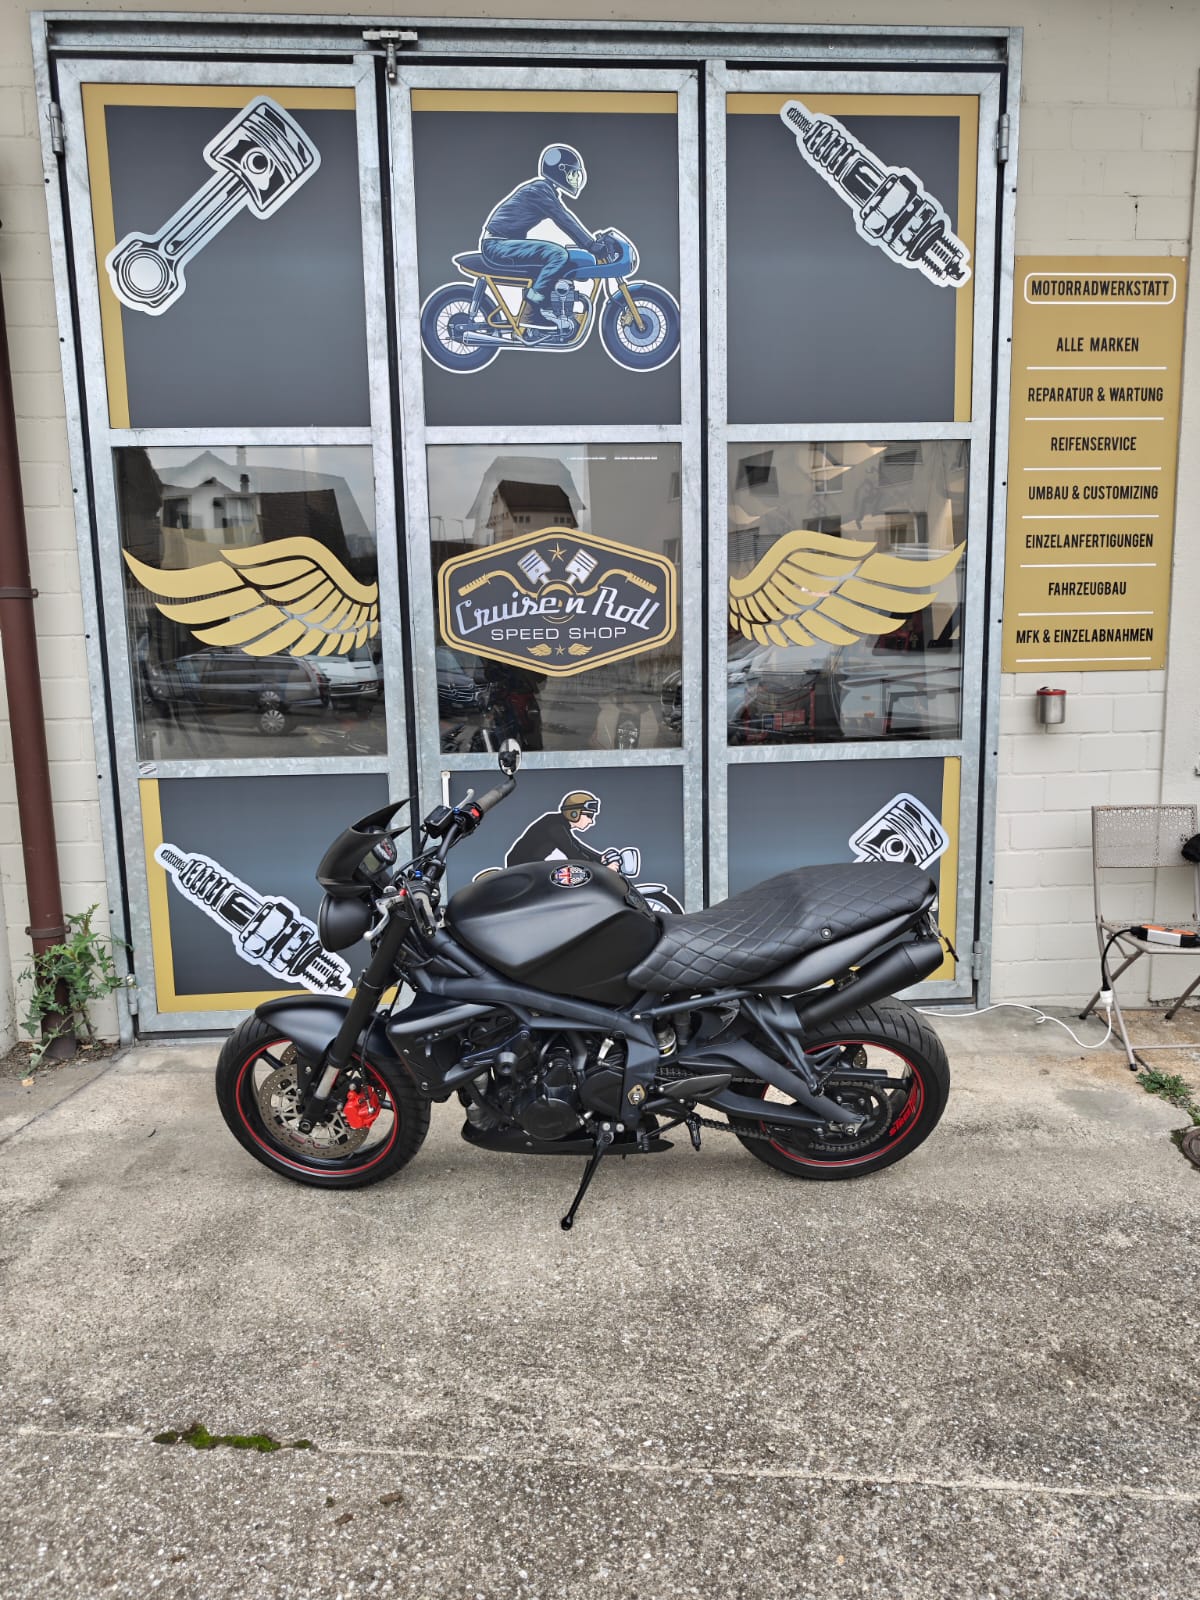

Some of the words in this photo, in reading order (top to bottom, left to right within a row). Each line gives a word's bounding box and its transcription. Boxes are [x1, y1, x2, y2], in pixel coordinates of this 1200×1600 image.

[1031, 280, 1169, 296] MOTORRADWERKSTATT
[1056, 337, 1084, 352] ALLE
[1089, 337, 1139, 352] MARKEN
[1028, 387, 1094, 402] REPARATUR
[1097, 387, 1106, 402] &
[1109, 387, 1164, 402] WARTUNG
[1050, 437, 1137, 451] REIFENSERVICE
[1028, 486, 1069, 500] UMBAU
[1071, 486, 1080, 500] &
[1083, 485, 1158, 500] CUSTOMIZING
[1025, 533, 1154, 548] EINZELANFERTIGUNGEN
[1048, 582, 1127, 596] FAHRZEUGBAU
[455, 591, 561, 635] Cruise
[591, 586, 660, 630] Roll
[491, 628, 560, 641] SPEED
[568, 626, 627, 640] SHOP
[1016, 629, 1040, 644] MFK
[1042, 629, 1051, 643] &
[1053, 628, 1154, 643] EINZELABNAHMEN
